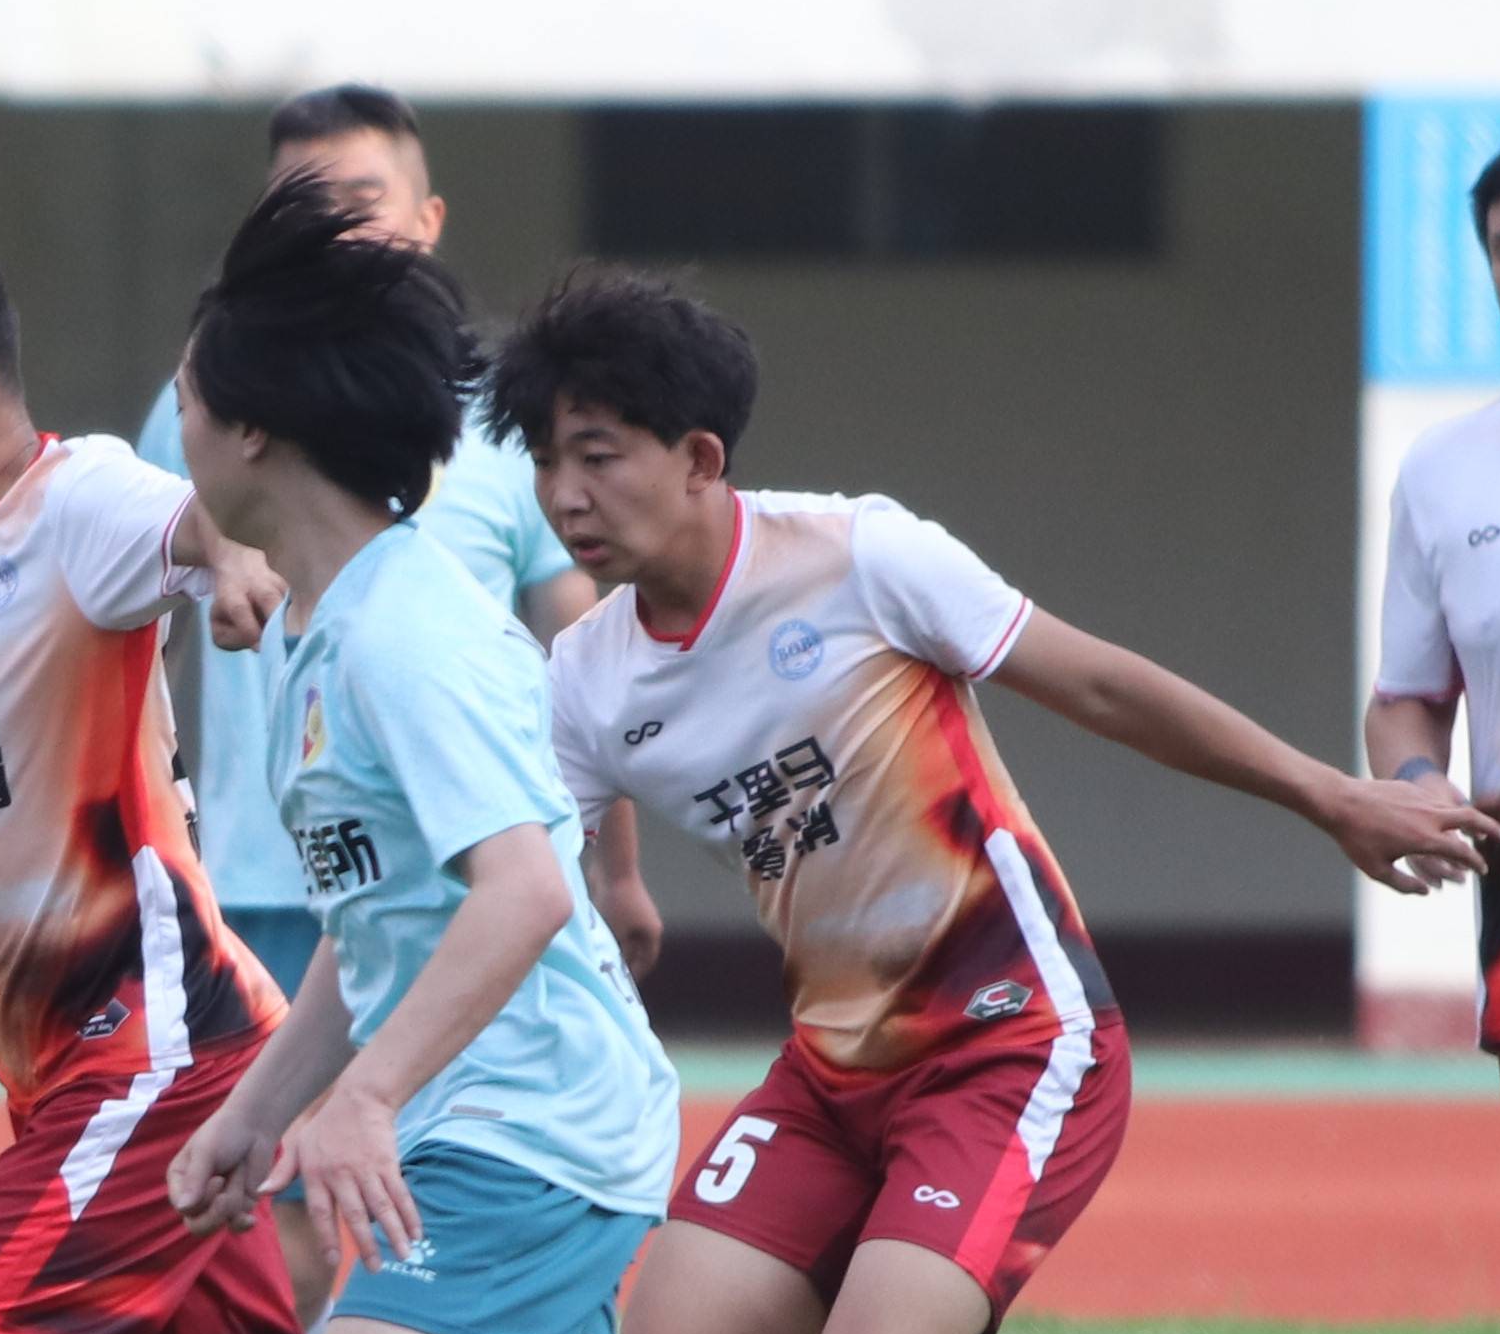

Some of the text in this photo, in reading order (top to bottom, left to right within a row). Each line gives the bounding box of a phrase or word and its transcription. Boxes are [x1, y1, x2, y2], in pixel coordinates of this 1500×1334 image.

[693, 735, 835, 833] 千里马
[694, 1114, 779, 1203] 5
